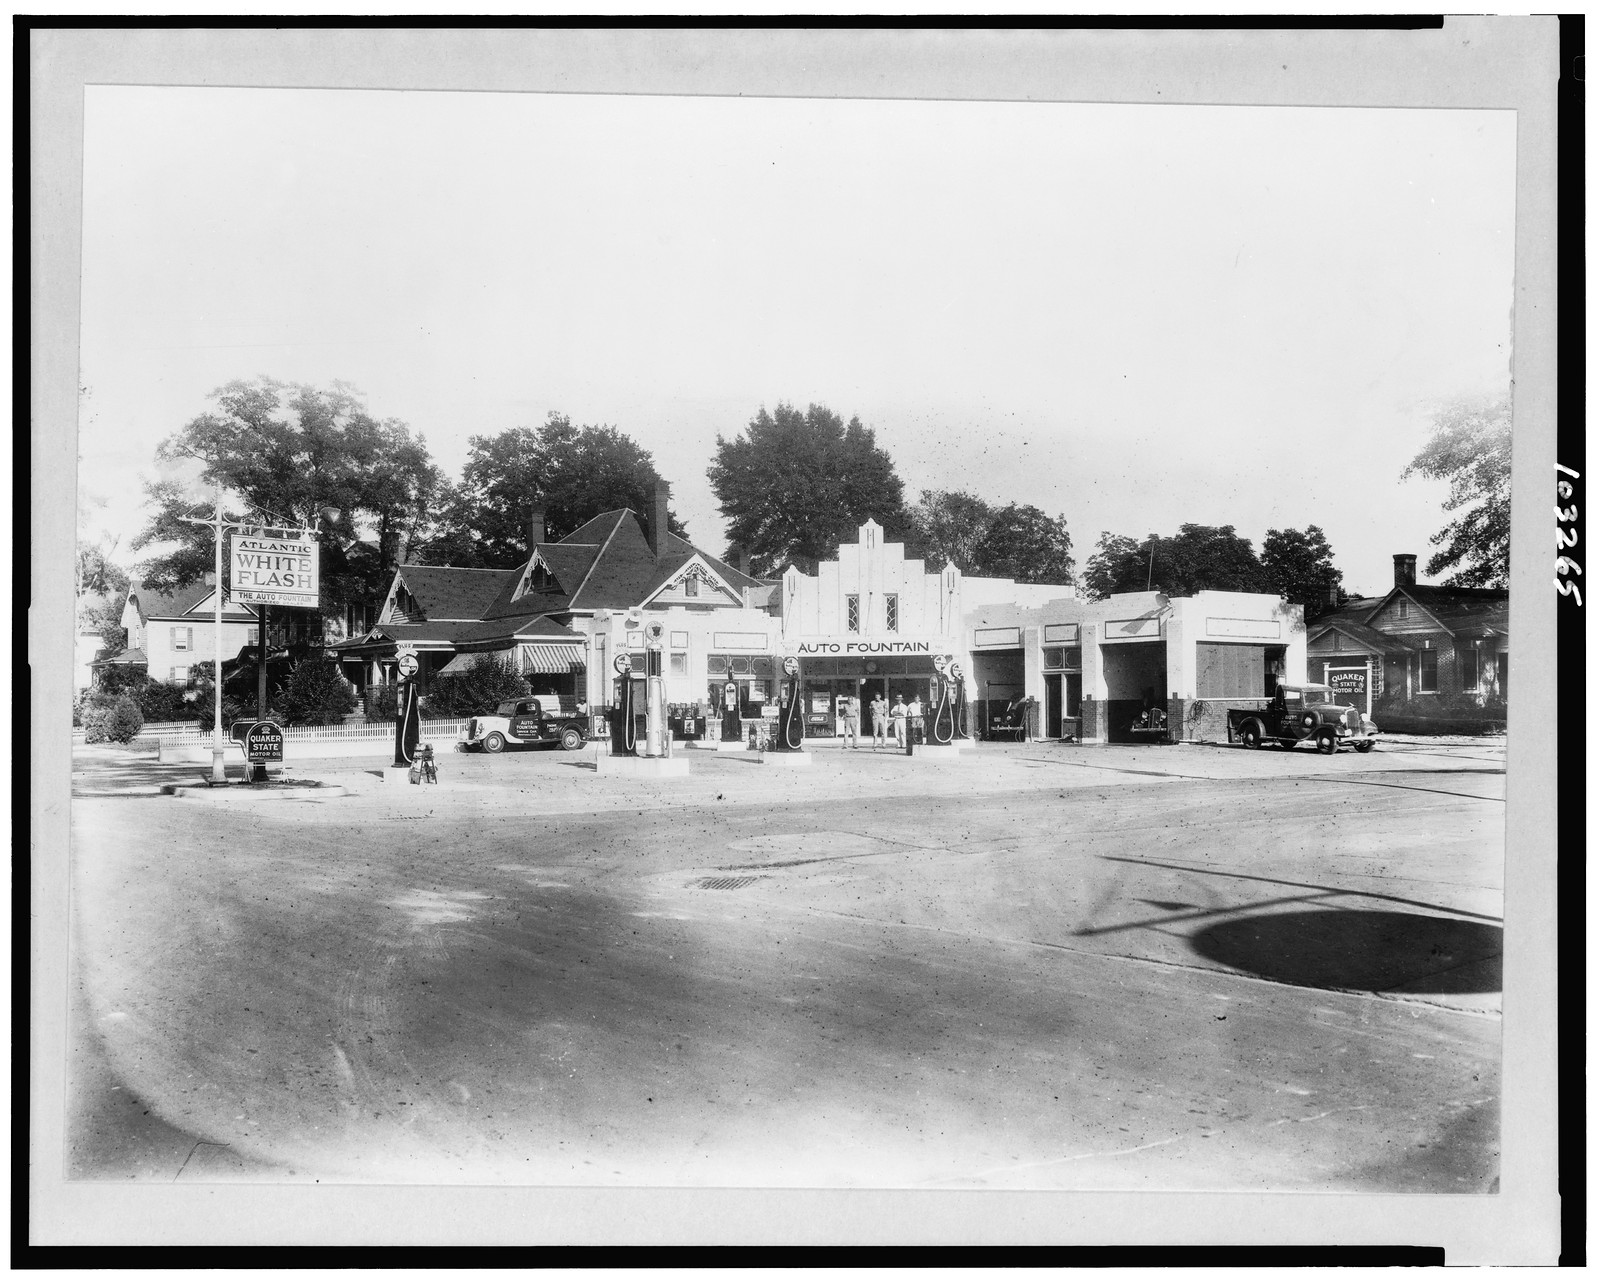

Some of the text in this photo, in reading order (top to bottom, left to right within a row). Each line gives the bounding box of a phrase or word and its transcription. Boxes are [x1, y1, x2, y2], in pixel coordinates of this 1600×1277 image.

[1553, 462, 1582, 607] 103265
[239, 541, 311, 553] ATLANTIC
[236, 554, 312, 572] WHITE
[238, 571, 312, 588] FLASH
[239, 592, 253, 600] THE
[279, 594, 312, 602] FOUNTAIN
[798, 642, 841, 653] AUTO
[847, 642, 929, 653] FOUNTAIN
[1332, 674, 1364, 682] QUAKER
